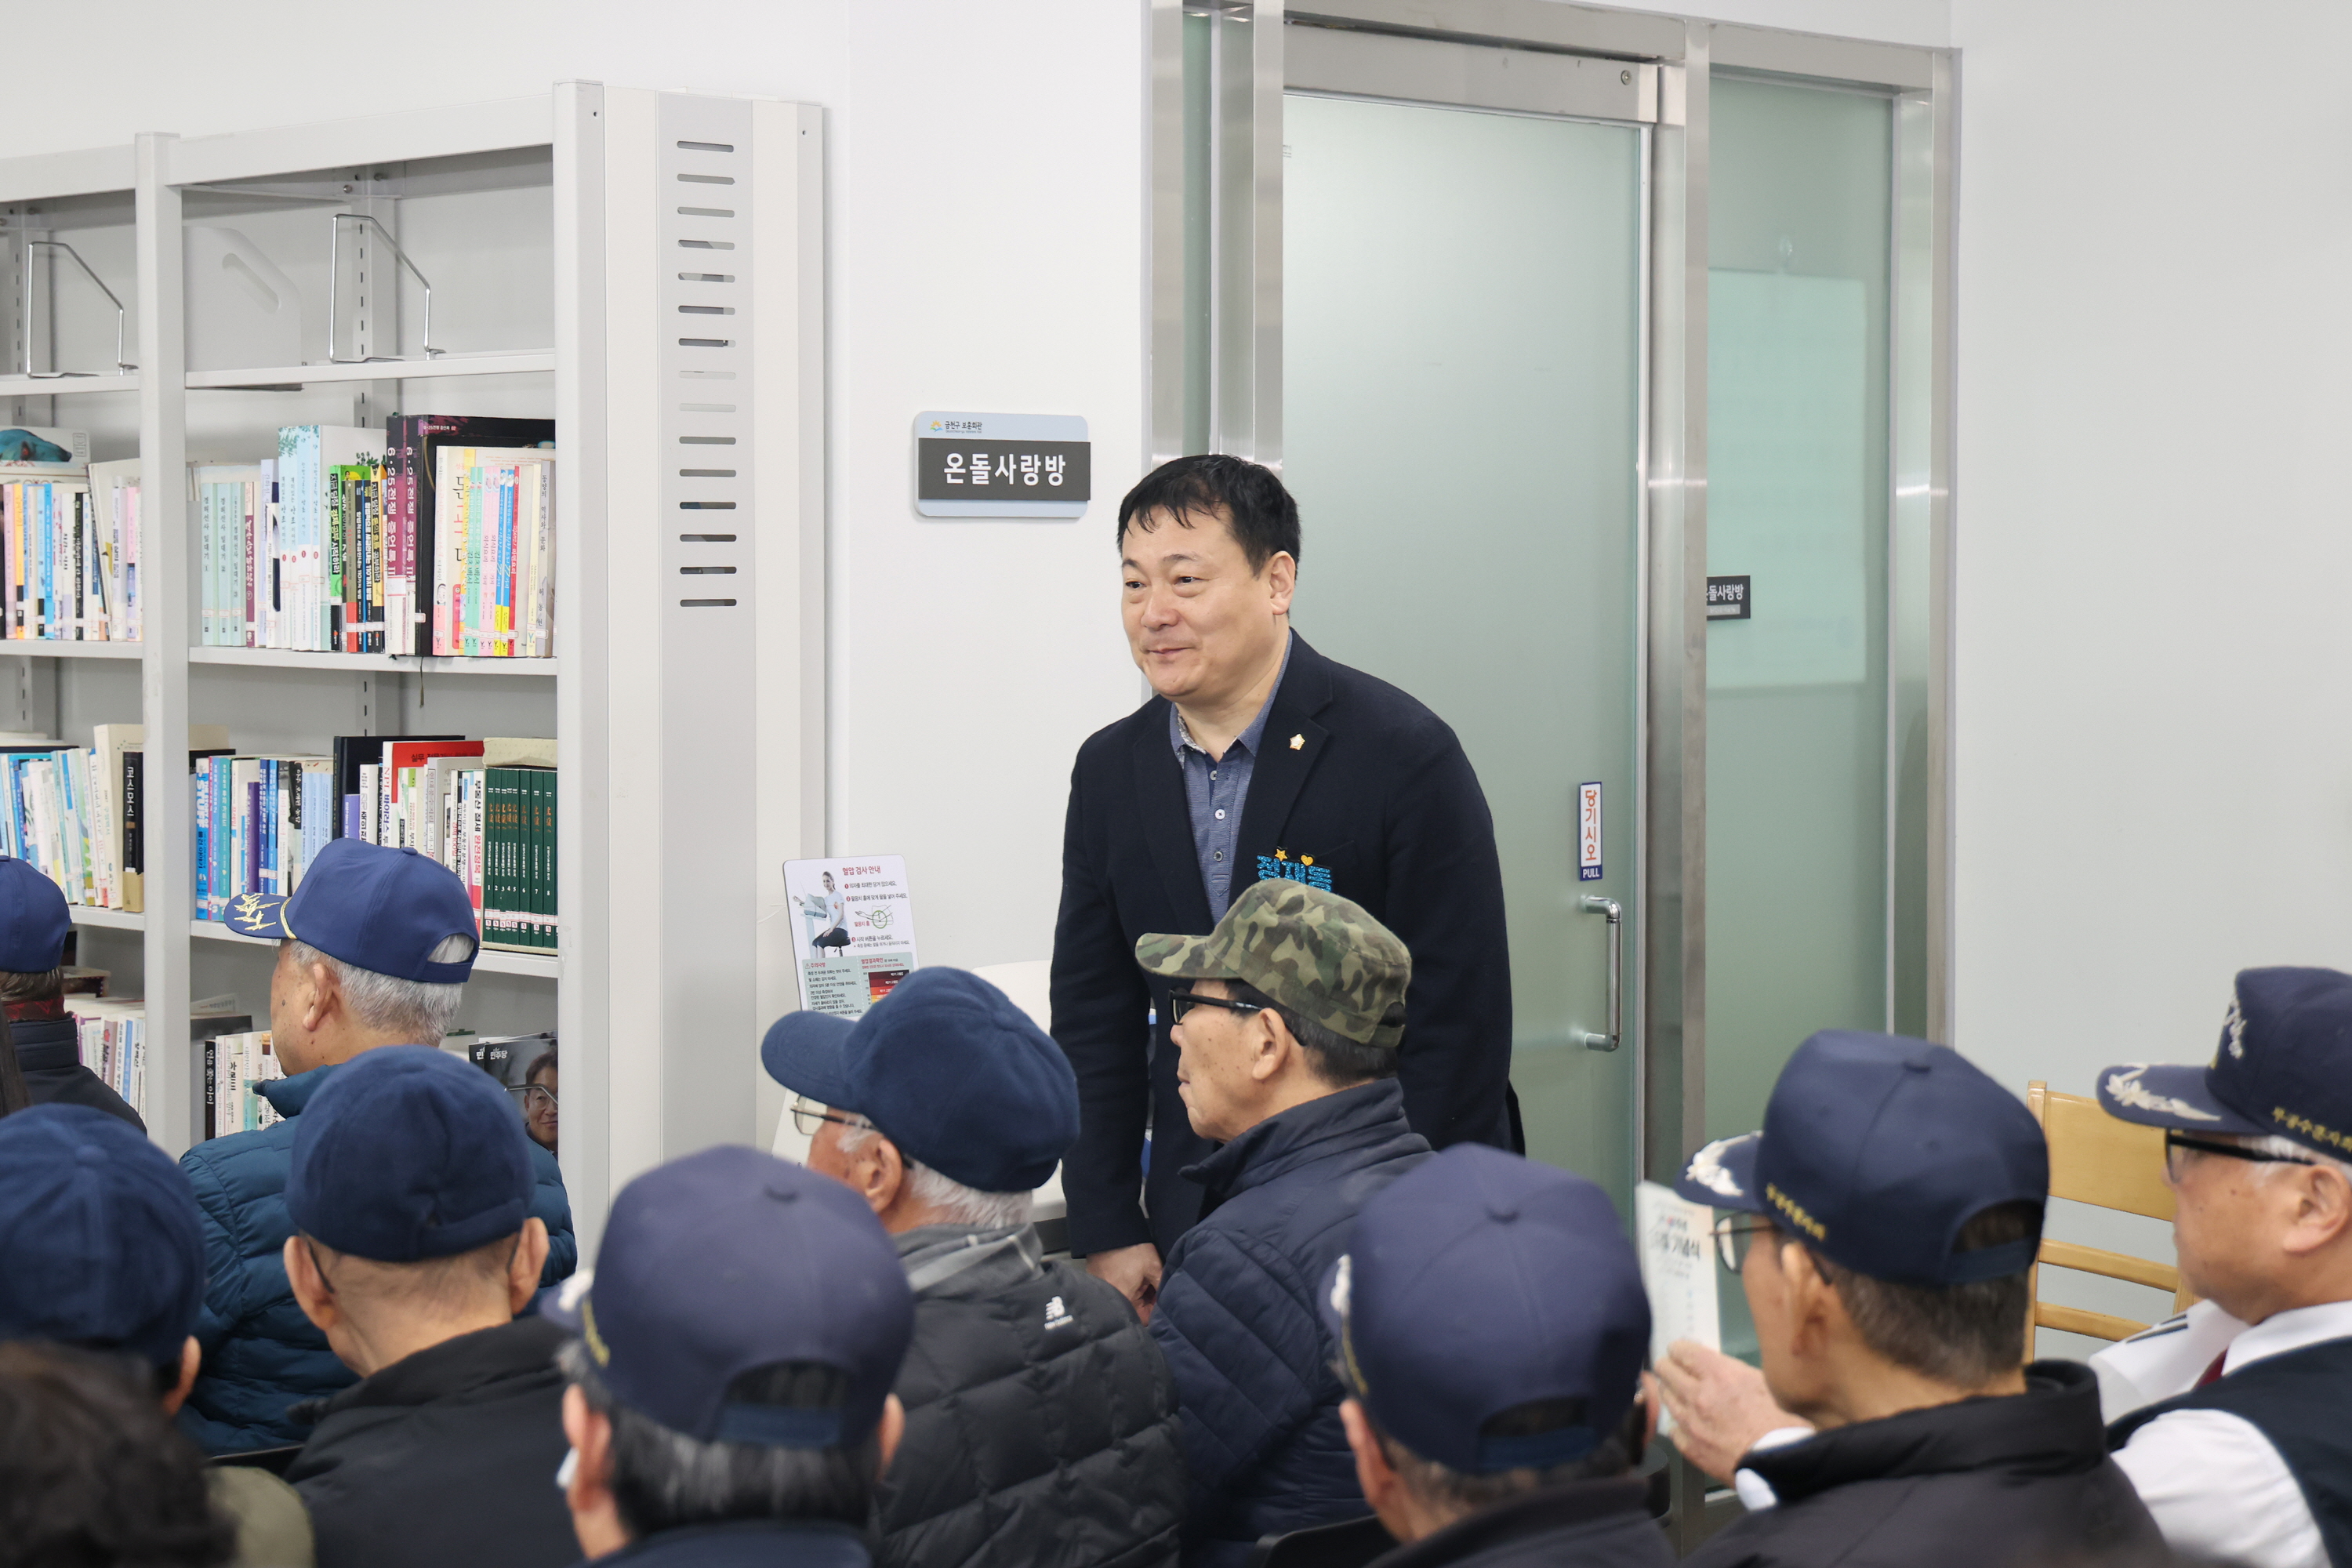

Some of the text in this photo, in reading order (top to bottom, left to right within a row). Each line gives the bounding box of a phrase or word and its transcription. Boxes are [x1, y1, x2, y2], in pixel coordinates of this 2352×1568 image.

[944, 421, 982, 430] 금천구 보훈회관
[943, 452, 1066, 487] 온돌사랑방
[387, 447, 397, 515] 6·25전쟁
[406, 447, 415, 514] 6·25전쟁
[387, 521, 397, 563] 증언록
[540, 536, 546, 552] 문화
[332, 542, 340, 573] 시작하라
[365, 588, 371, 601] 방법
[1706, 583, 1744, 601] 돌사랑방
[126, 766, 135, 817] 코스모스
[196, 779, 205, 829] STUFF
[474, 812, 481, 832] 절세
[1584, 789, 1598, 861] 당기시오
[842, 866, 881, 876] 혈압 검사 안내
[1582, 867, 1600, 879] PULL
[206, 1049, 214, 1066] 연을
[490, 1051, 508, 1060] 민주당
[206, 1086, 214, 1105] 아이
